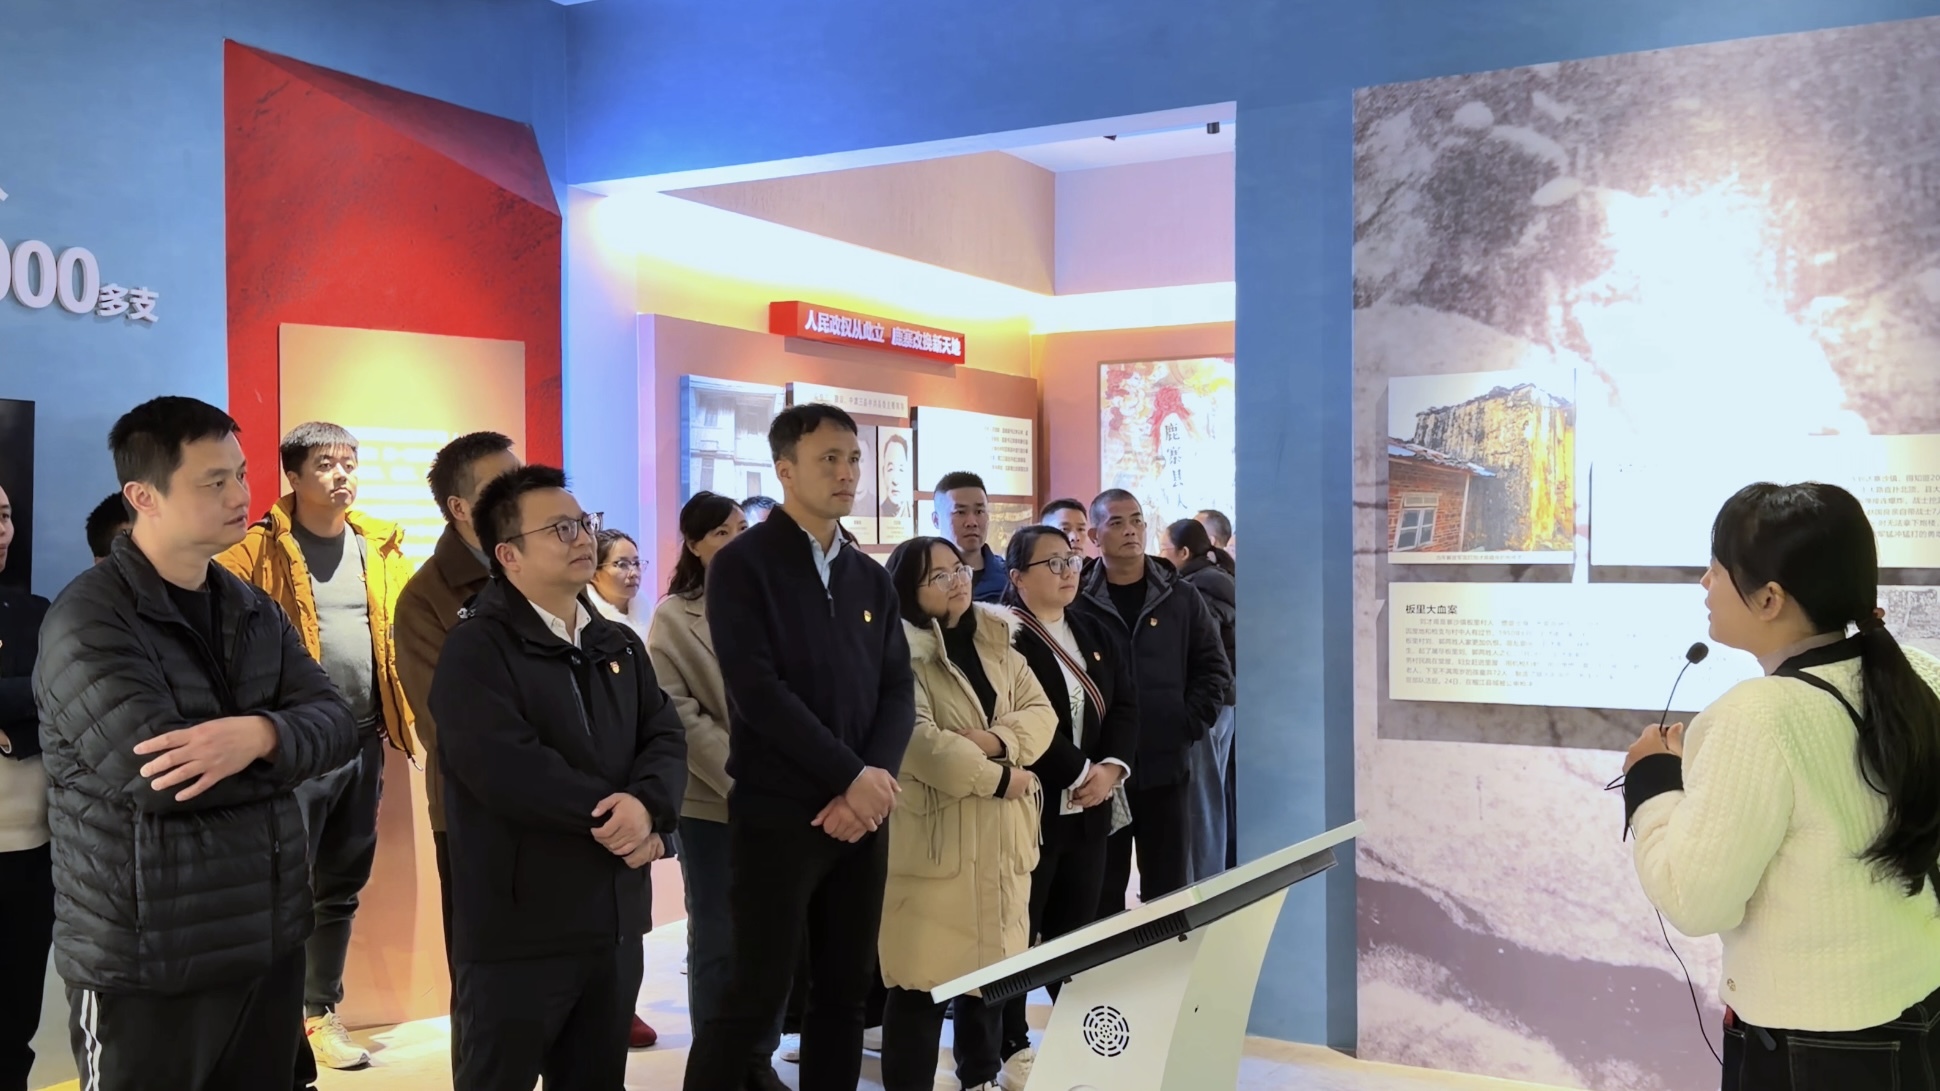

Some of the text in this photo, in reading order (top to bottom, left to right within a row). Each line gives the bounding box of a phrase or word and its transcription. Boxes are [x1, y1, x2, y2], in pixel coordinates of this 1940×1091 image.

[0, 237, 159, 323] 00多支
[804, 309, 962, 356] 人民政权从此立 鹿寨改换新天地
[1405, 604, 1458, 615] 板里大血案
